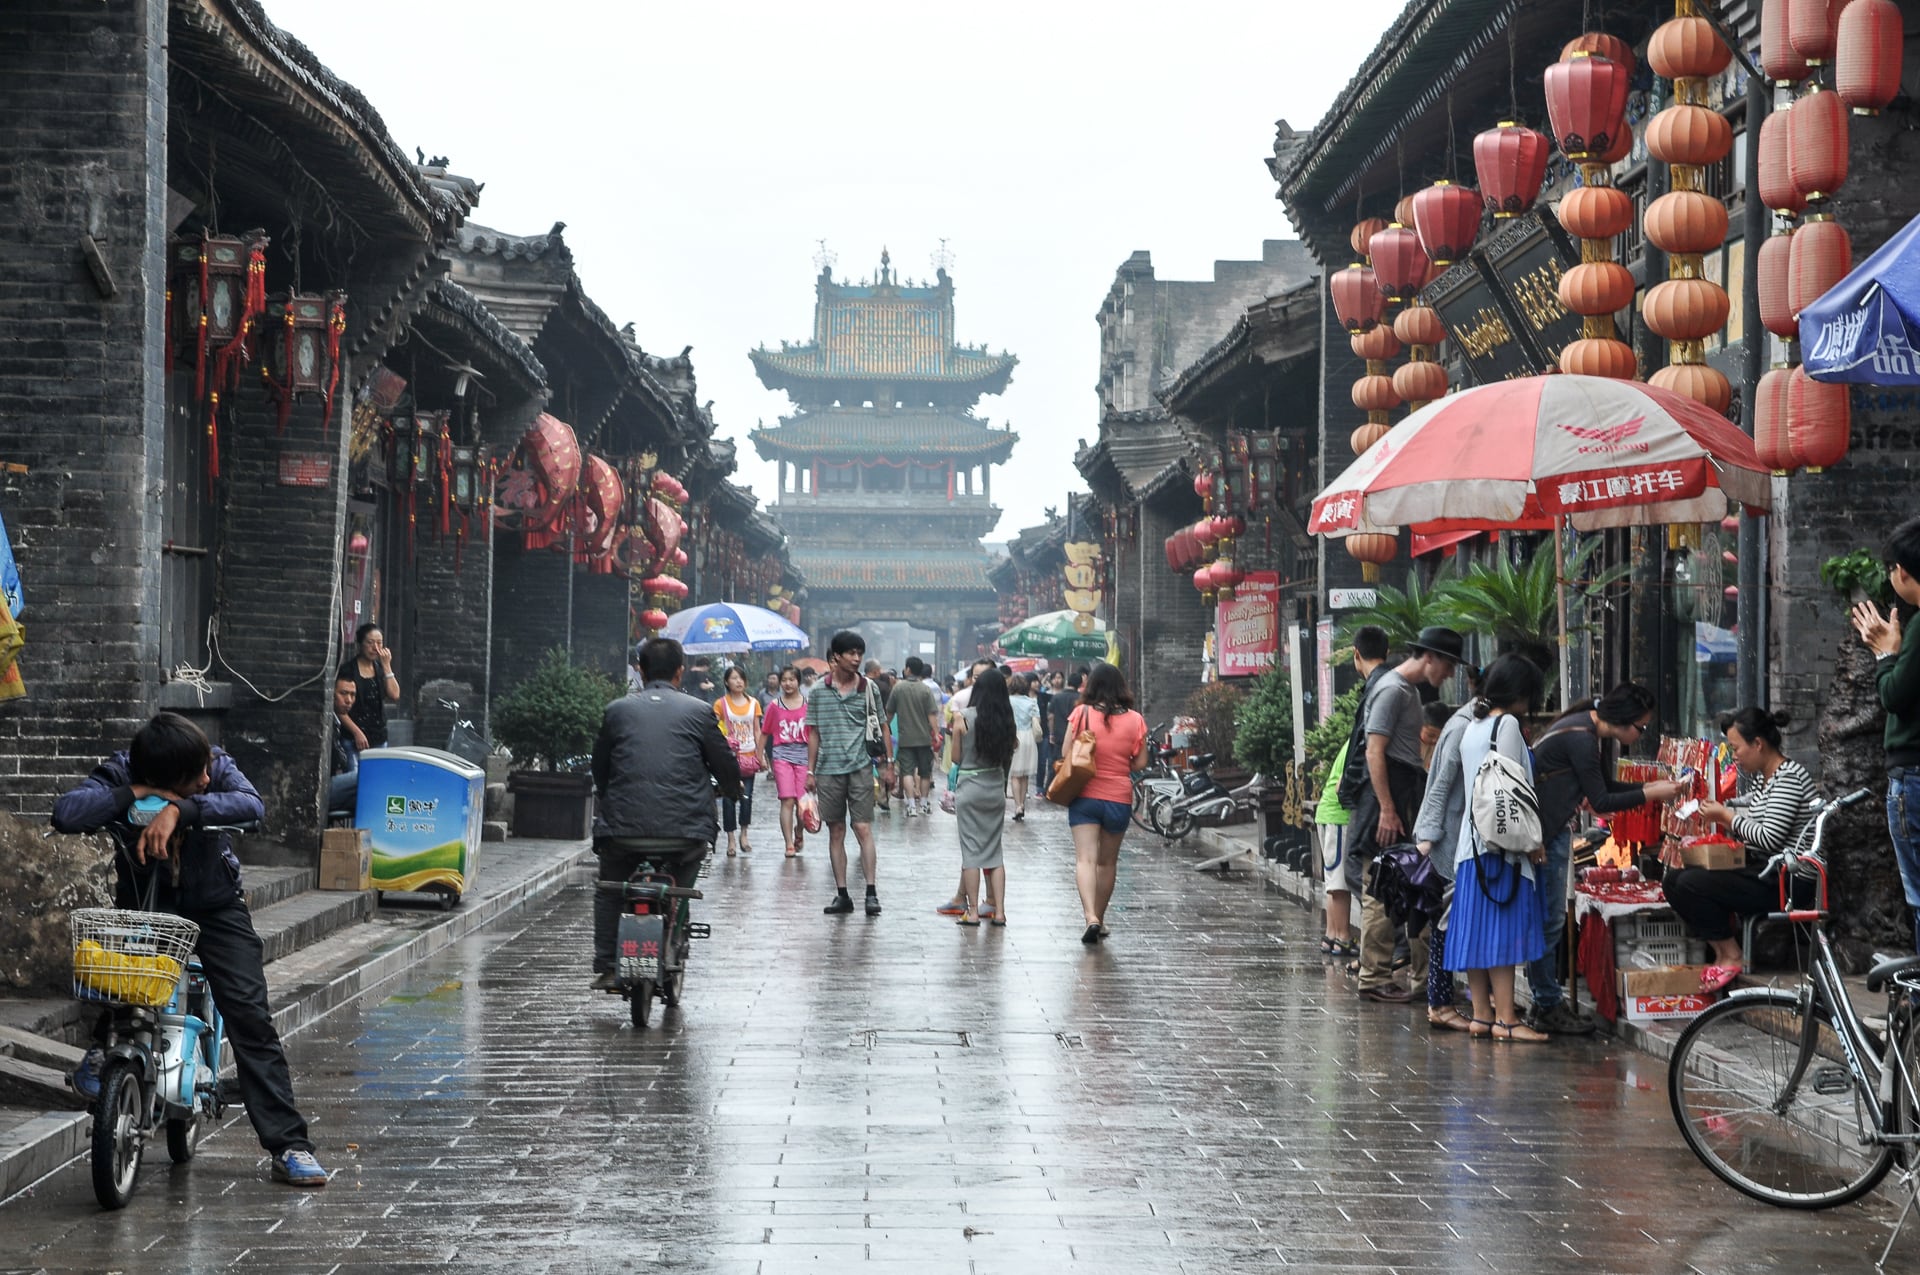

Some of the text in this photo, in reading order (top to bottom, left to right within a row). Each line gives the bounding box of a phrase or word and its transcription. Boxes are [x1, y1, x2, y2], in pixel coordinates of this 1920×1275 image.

[1346, 591, 1375, 601] WLAN
[1494, 789, 1507, 834] SIMONS
[1509, 799, 1519, 823] RAF
